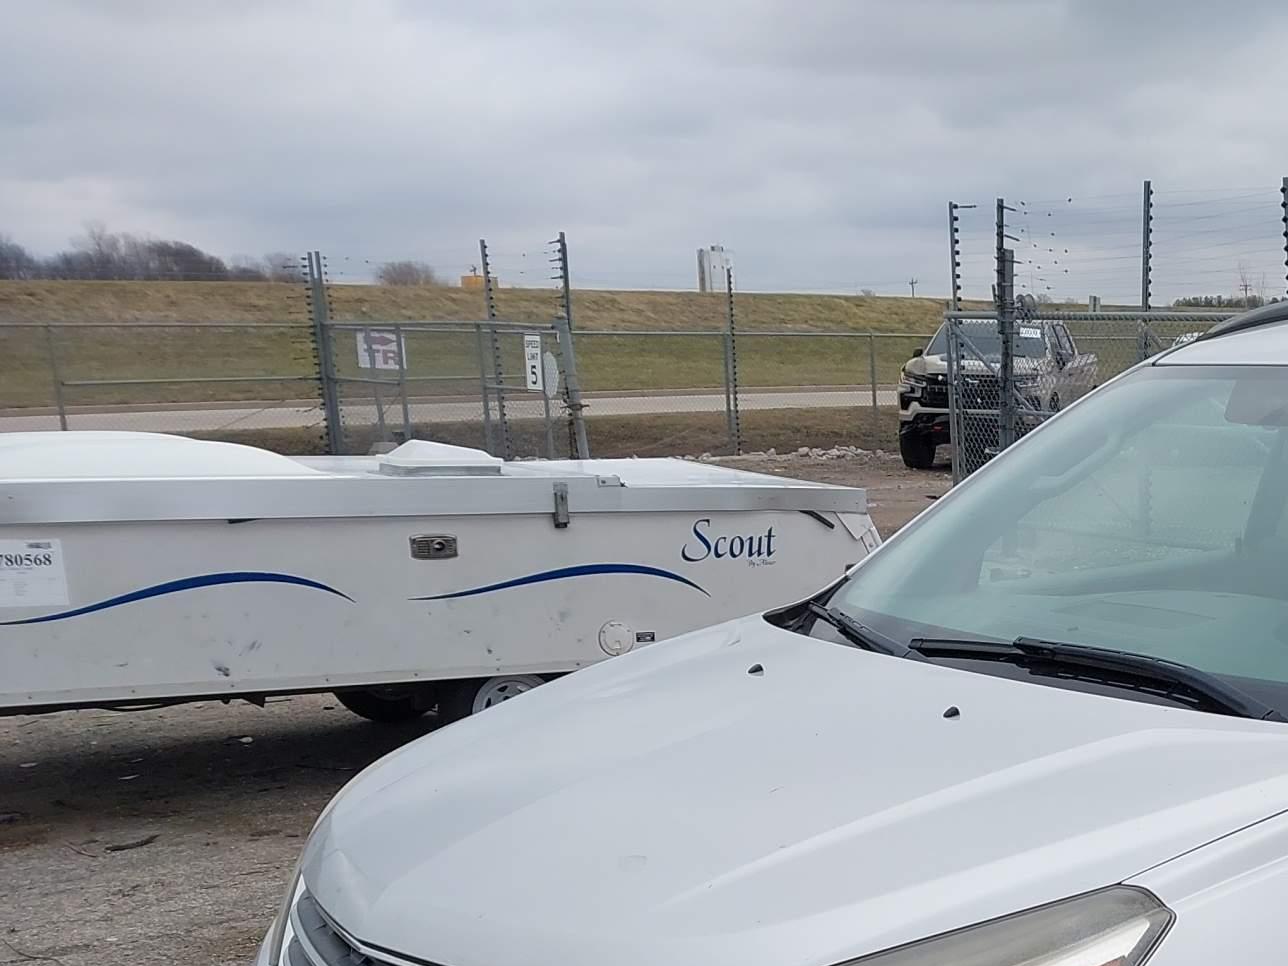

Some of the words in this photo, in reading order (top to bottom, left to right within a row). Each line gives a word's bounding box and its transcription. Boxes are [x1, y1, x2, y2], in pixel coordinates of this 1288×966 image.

[525, 340, 539, 348] SPEED
[530, 364, 538, 386] 5
[681, 518, 777, 562] Scout
